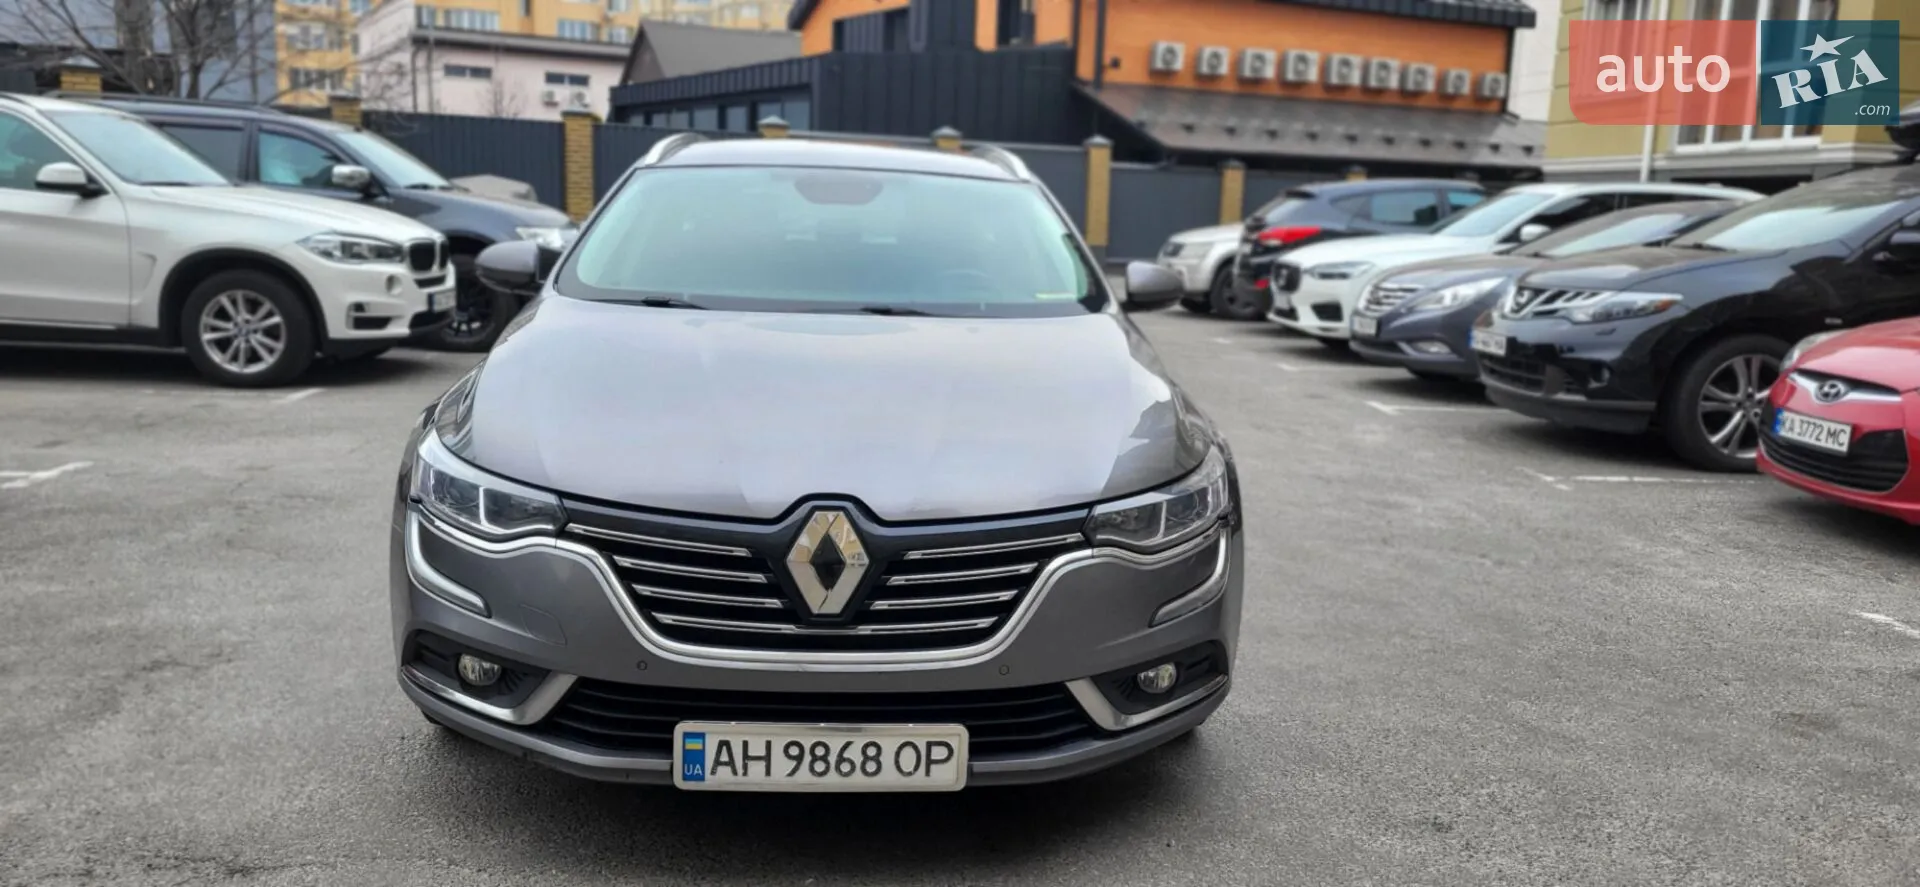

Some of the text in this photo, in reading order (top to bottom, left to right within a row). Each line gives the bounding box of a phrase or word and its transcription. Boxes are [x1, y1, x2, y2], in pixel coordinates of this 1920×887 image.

[1797, 419, 1824, 442] 3772
[1825, 427, 1847, 447] MC
[684, 763, 703, 776] UA
[709, 739, 955, 778] AH 9868 OP
